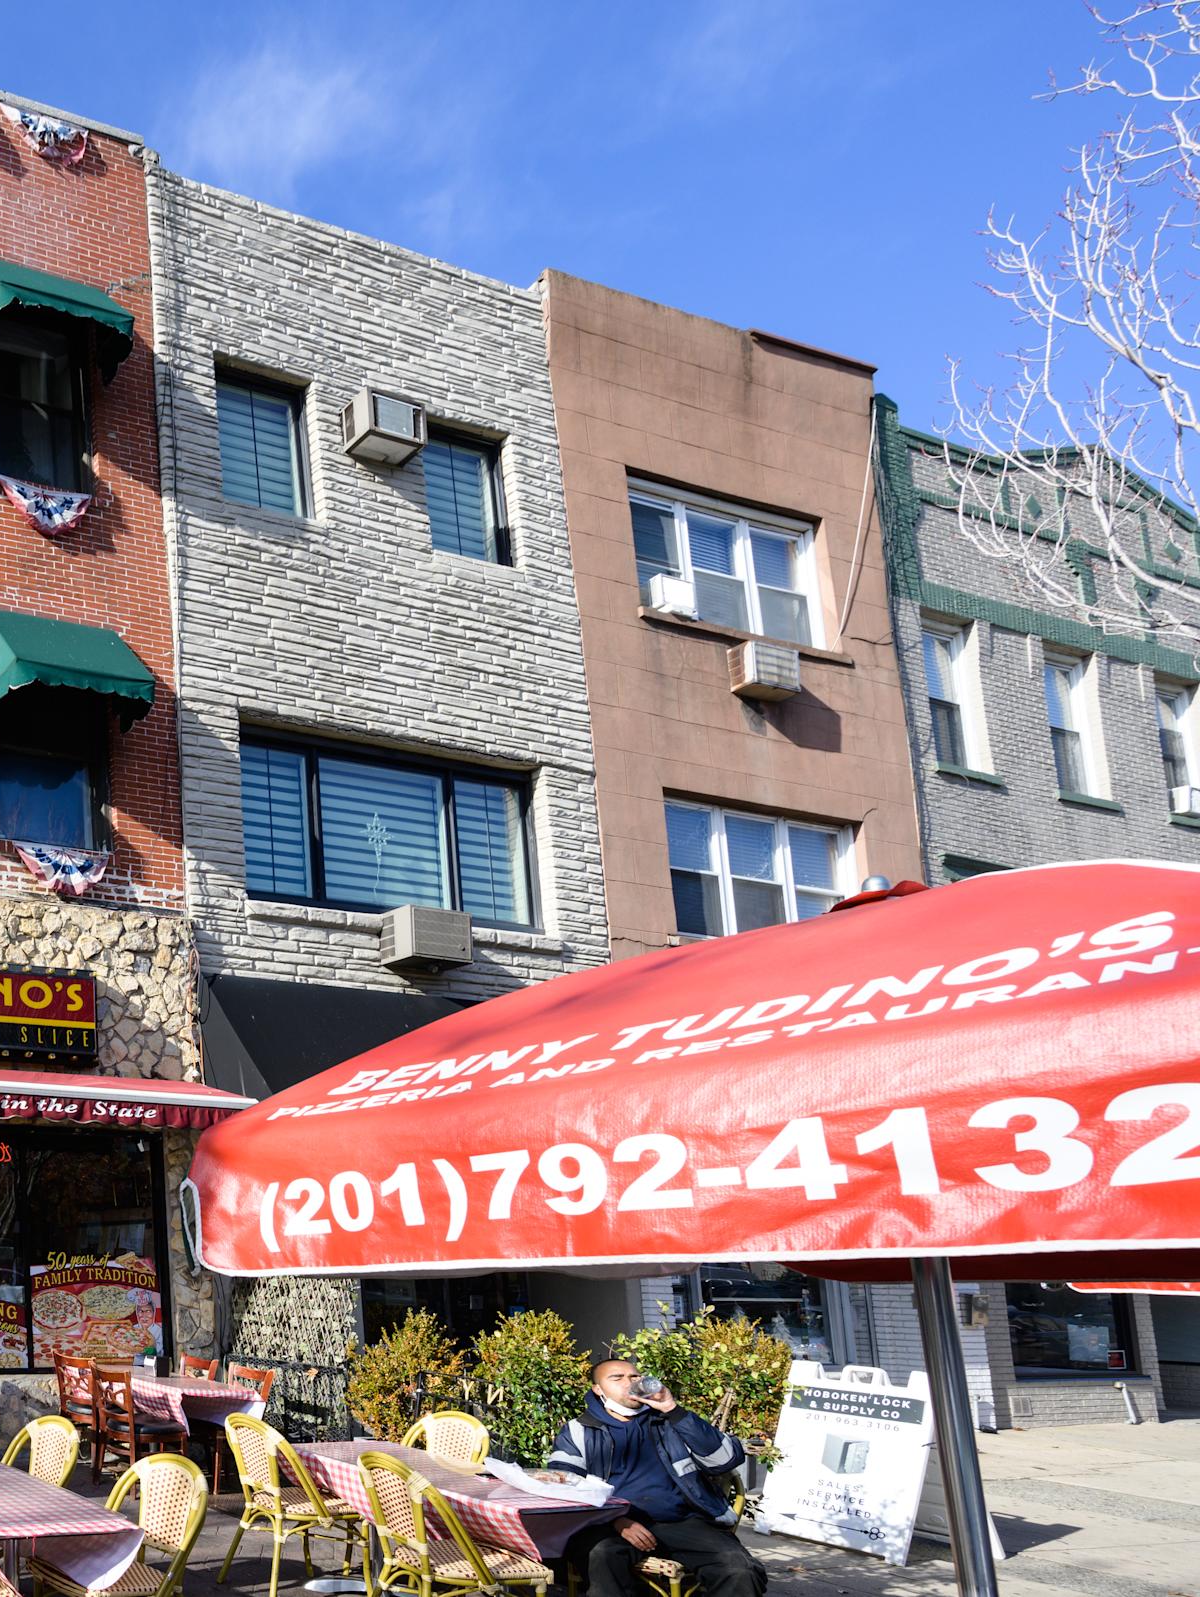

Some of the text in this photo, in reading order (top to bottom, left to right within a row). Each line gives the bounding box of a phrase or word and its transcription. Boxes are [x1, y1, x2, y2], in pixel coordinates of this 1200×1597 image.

[327, 911, 1176, 1096] BENNY TUDINO'S
[20, 1026, 89, 1047] SLICE
[266, 947, 1200, 1121] PIZZERIA AND RESTAURAN
[0, 1094, 30, 1111] in
[36, 1097, 79, 1114] the
[92, 1100, 158, 1120] State
[259, 1082, 1200, 1253] (201)792-4132
[46, 1251, 67, 1270] 50
[69, 1254, 96, 1270] years
[34, 1268, 157, 1289] FAMILY TRADITION
[803, 1388, 911, 1409] HOBOKEN LOCK
[809, 1400, 901, 1419] & SUPPLY CO
[817, 1479, 860, 1493] SALES
[808, 1488, 865, 1506] SERVICE
[797, 1497, 872, 1519] INSTALLED
